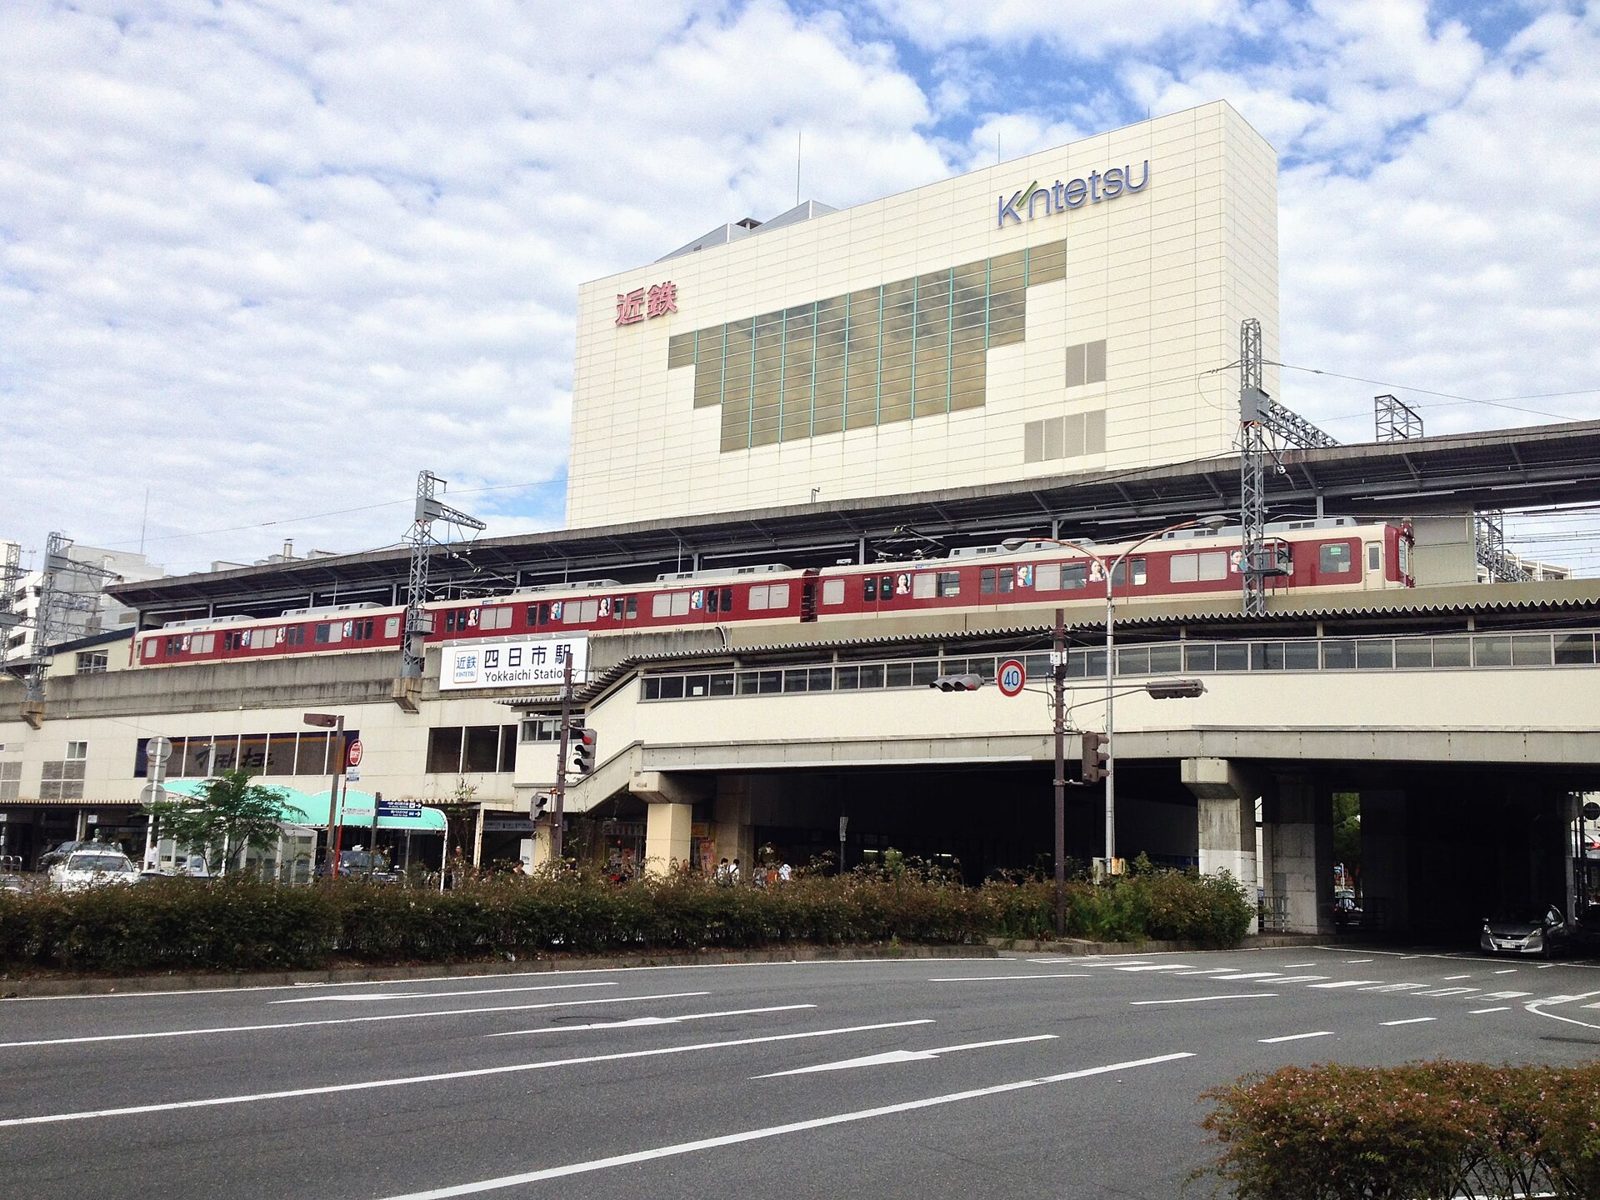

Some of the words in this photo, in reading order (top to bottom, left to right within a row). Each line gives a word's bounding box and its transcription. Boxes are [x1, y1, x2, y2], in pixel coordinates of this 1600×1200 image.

[998, 160, 1149, 228] Kintetsu
[615, 281, 678, 327] 近鉄
[456, 656, 476, 670] 近鉄
[484, 644, 571, 668] 四日市駅
[485, 669, 531, 682] Yokkaichi
[534, 668, 567, 680] Statio
[1004, 670, 1019, 686] 40
